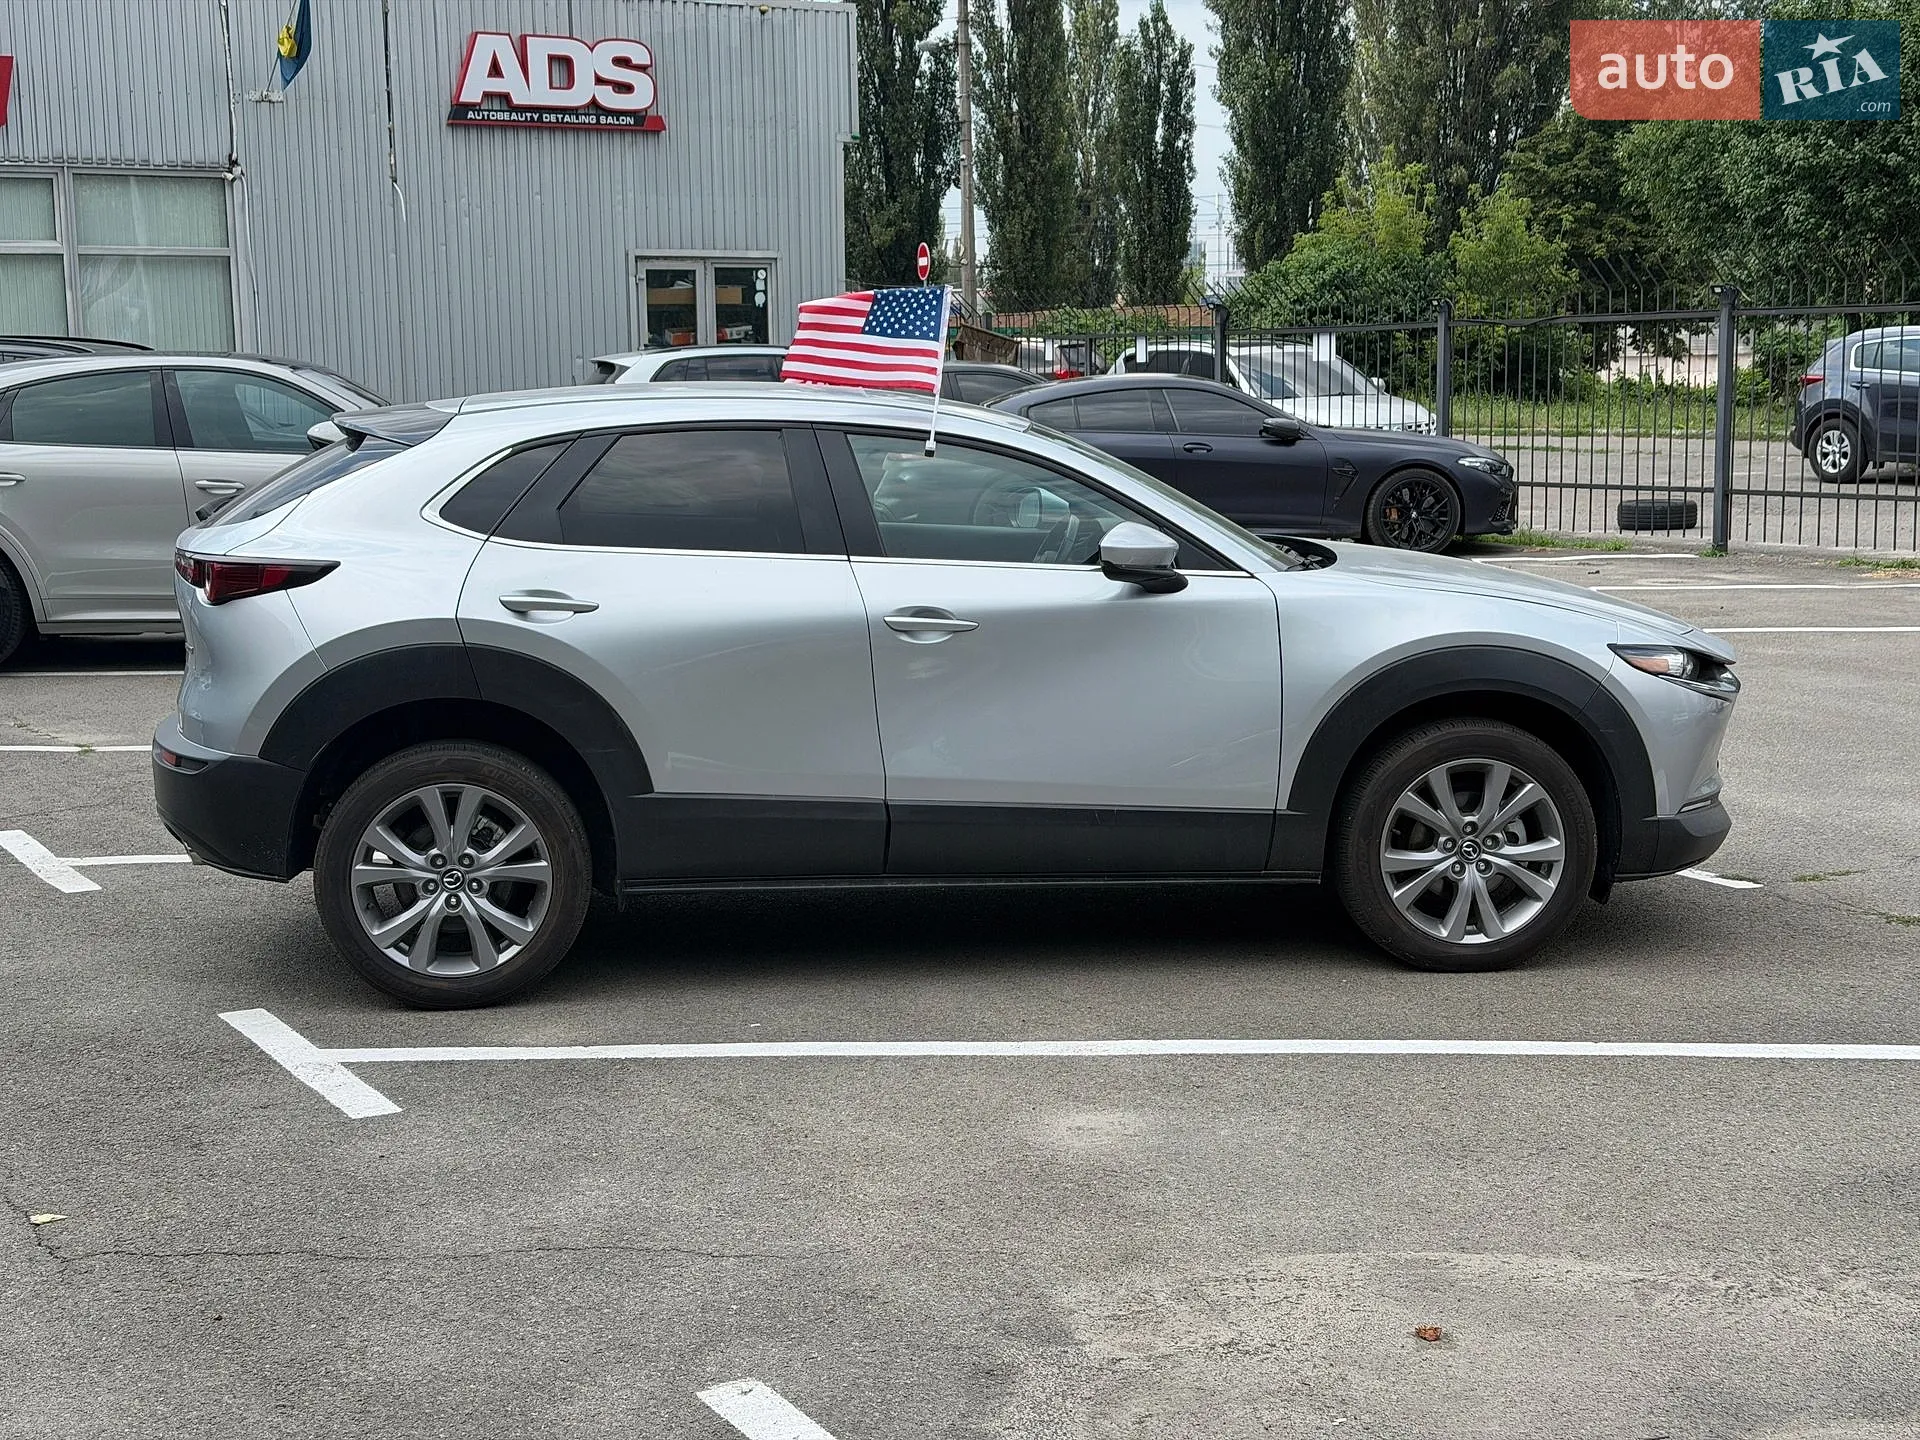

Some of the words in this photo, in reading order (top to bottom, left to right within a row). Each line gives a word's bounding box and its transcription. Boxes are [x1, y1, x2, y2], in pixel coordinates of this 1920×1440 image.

[457, 32, 656, 111] ADS
[466, 111, 541, 123] AUTOBEAUTY
[542, 113, 597, 125] DETAILING
[599, 115, 635, 126] SALON
